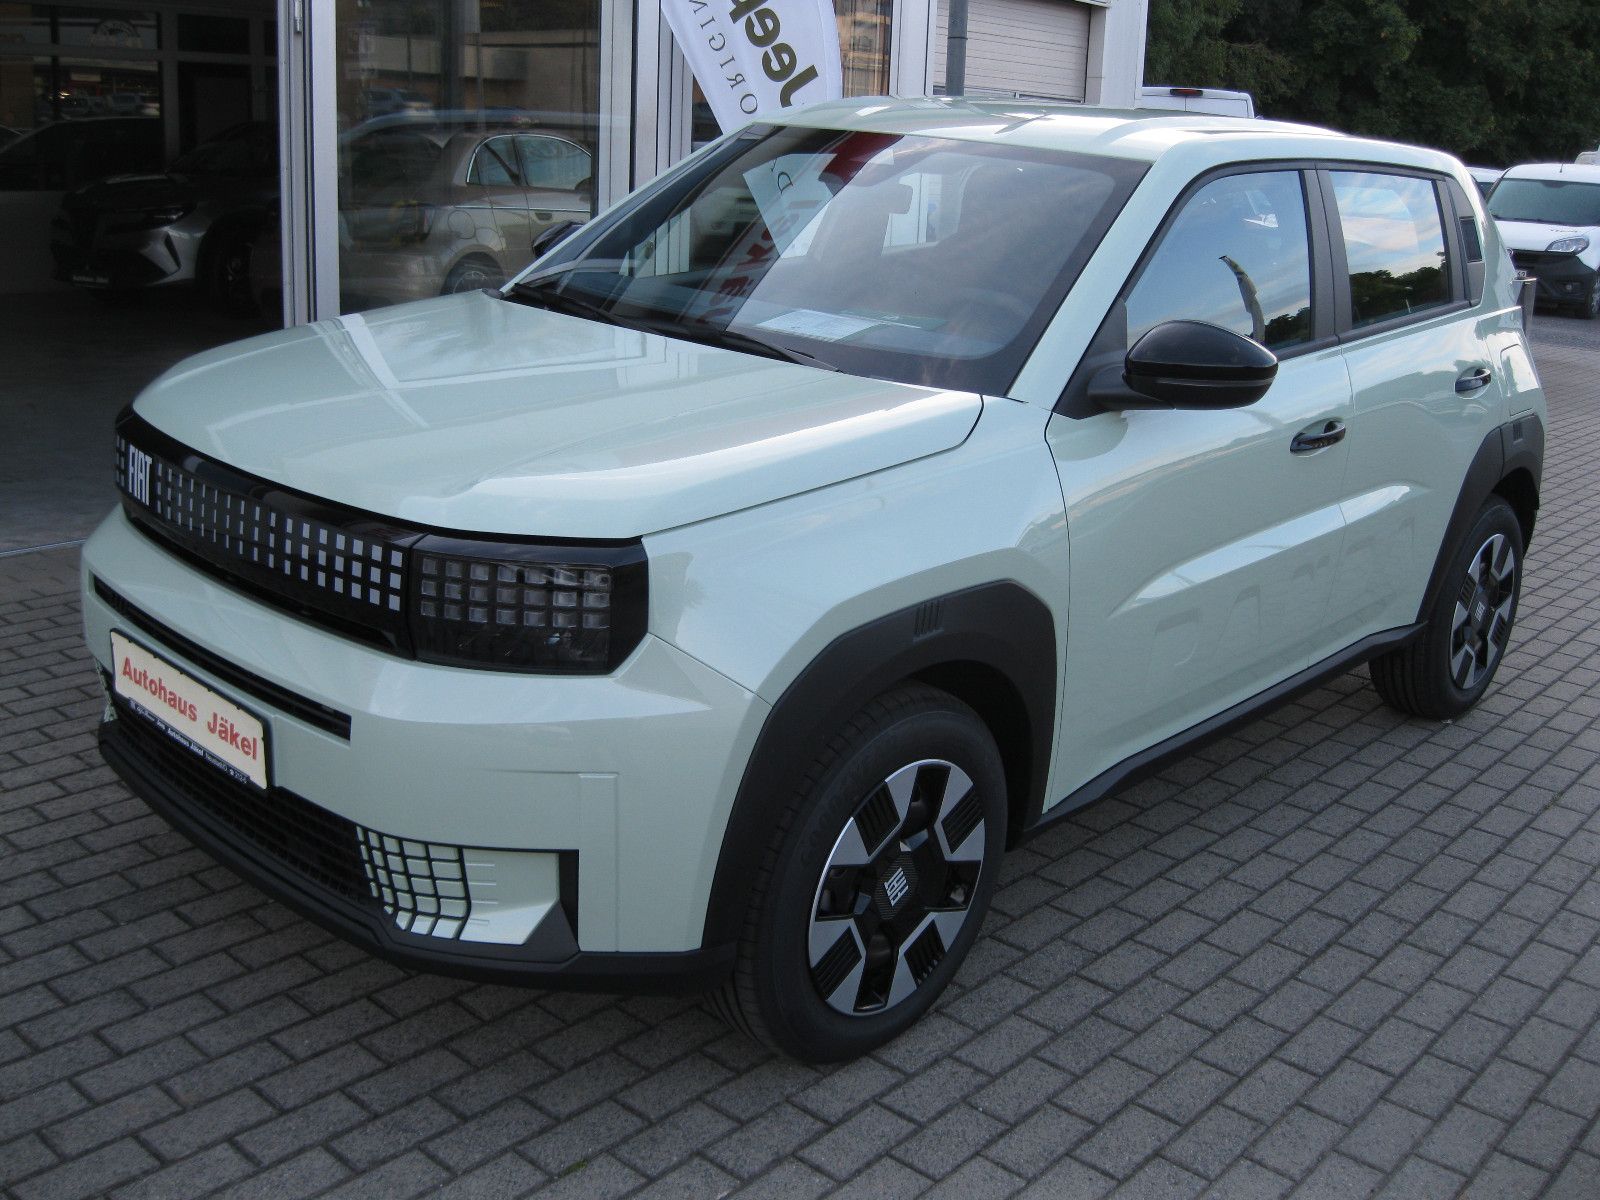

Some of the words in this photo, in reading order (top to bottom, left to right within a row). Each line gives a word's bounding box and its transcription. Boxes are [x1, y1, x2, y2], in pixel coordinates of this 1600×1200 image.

[129, 445, 152, 505] FIAT
[122, 656, 198, 722] Autohaus
[207, 712, 257, 760] Jäkel
